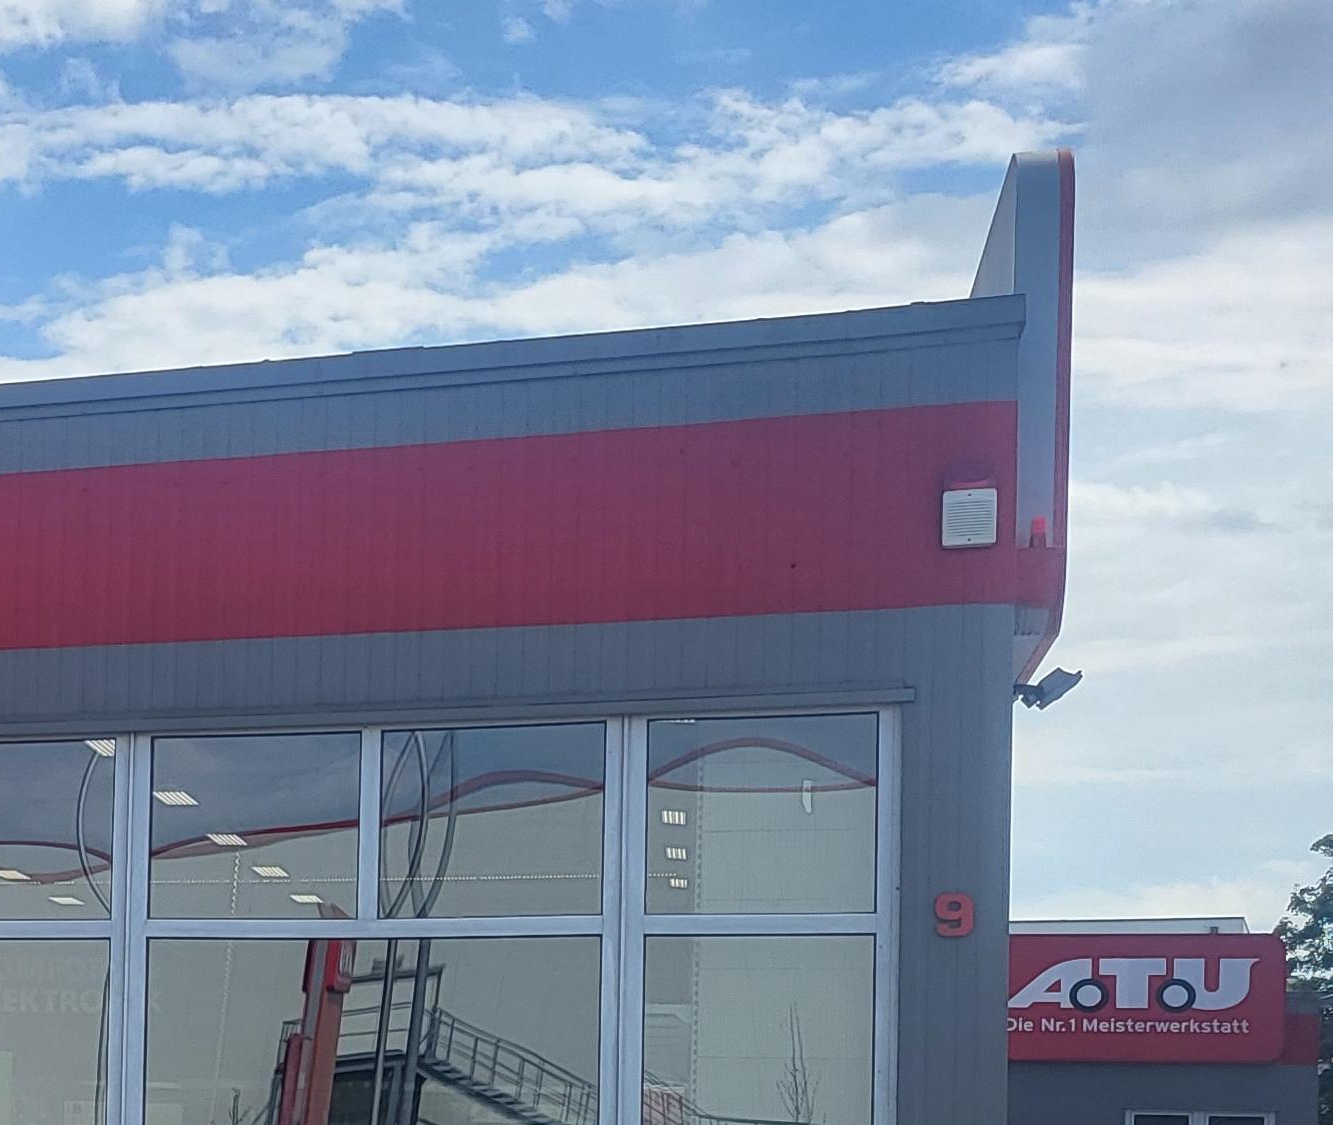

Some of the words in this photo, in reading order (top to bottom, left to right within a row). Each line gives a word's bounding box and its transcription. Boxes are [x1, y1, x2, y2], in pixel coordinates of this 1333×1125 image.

[935, 891, 974, 938] 9
[1007, 957, 1261, 1011] ATU
[1041, 1018, 1076, 1033] Nr.1
[1082, 1017, 1250, 1035] Meisterwerkstatt
